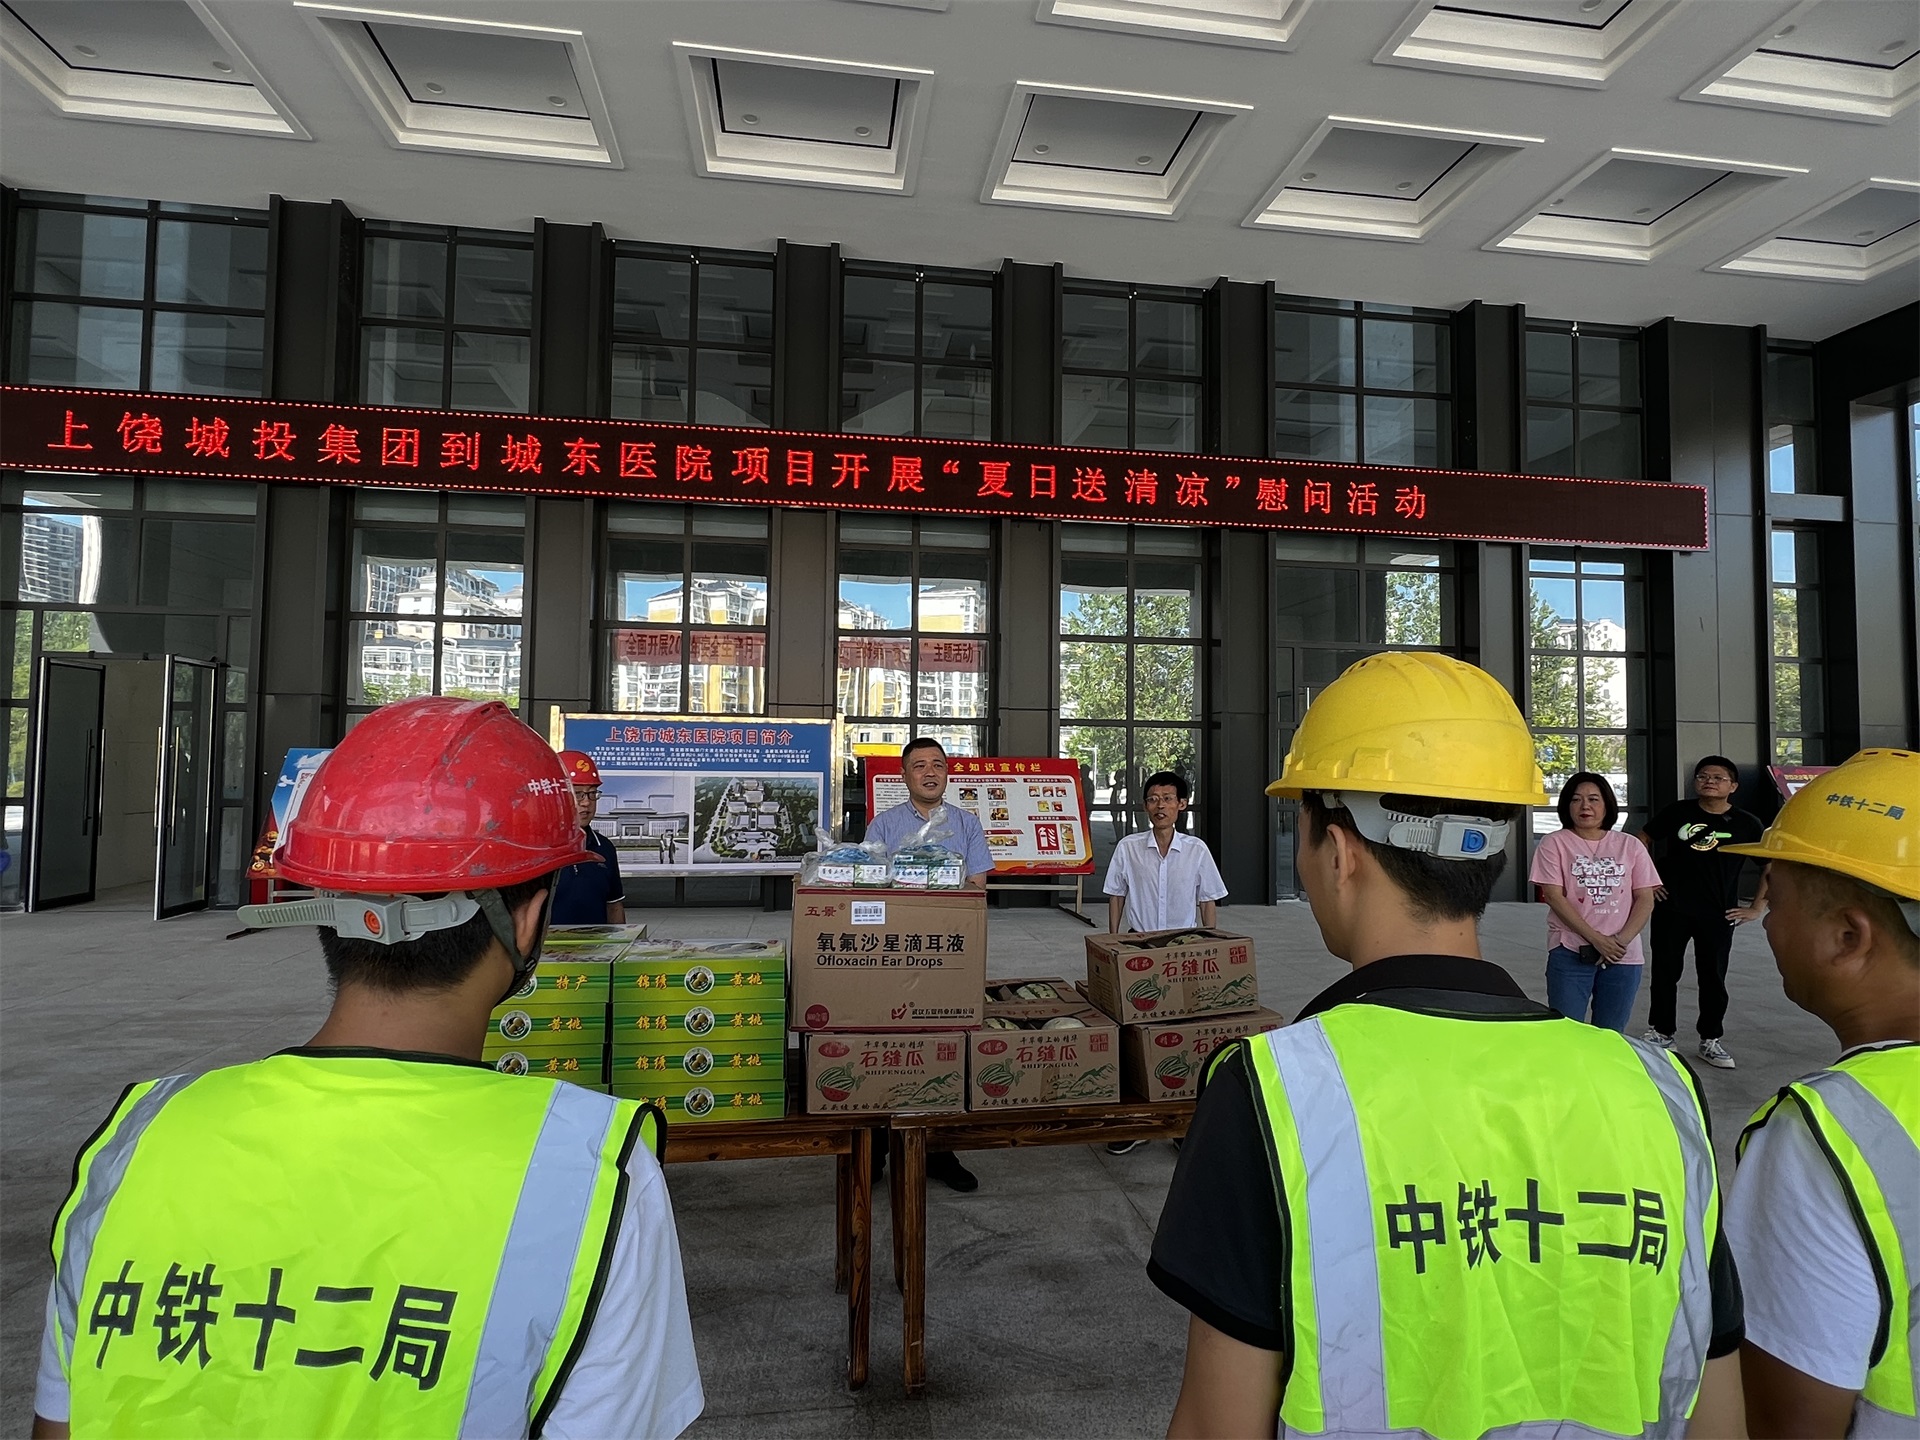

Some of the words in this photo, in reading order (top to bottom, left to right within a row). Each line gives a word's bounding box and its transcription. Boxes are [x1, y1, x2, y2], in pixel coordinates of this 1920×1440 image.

[605, 726, 794, 746] 上饶市城东医院项目简介
[1825, 793, 1907, 821] 中铁十二局
[805, 905, 837, 918] 五景
[816, 932, 966, 953] 氧氟沙星滴耳液
[816, 954, 878, 967] Ofloxacin
[881, 955, 902, 967] Ear
[905, 955, 944, 969] Drops
[1161, 957, 1220, 976] 石缝瓜
[555, 973, 589, 992] 特产
[635, 973, 669, 990] 锦绣
[729, 971, 764, 988] 黄桃
[547, 1016, 584, 1033] 黄桃
[635, 1014, 669, 1031] 锦绣
[729, 1011, 764, 1028] 黄桃
[544, 1057, 581, 1075] 黄桃
[634, 1054, 668, 1072] 锦绣
[728, 1051, 763, 1069] 黄桃
[859, 1049, 925, 1068] 石缝瓜
[1015, 1044, 1078, 1063] 石缝瓜
[729, 1092, 764, 1109] 黄桃
[1384, 1177, 1668, 1276] 中铁十二局
[88, 1259, 459, 1391] 中铁十二局
